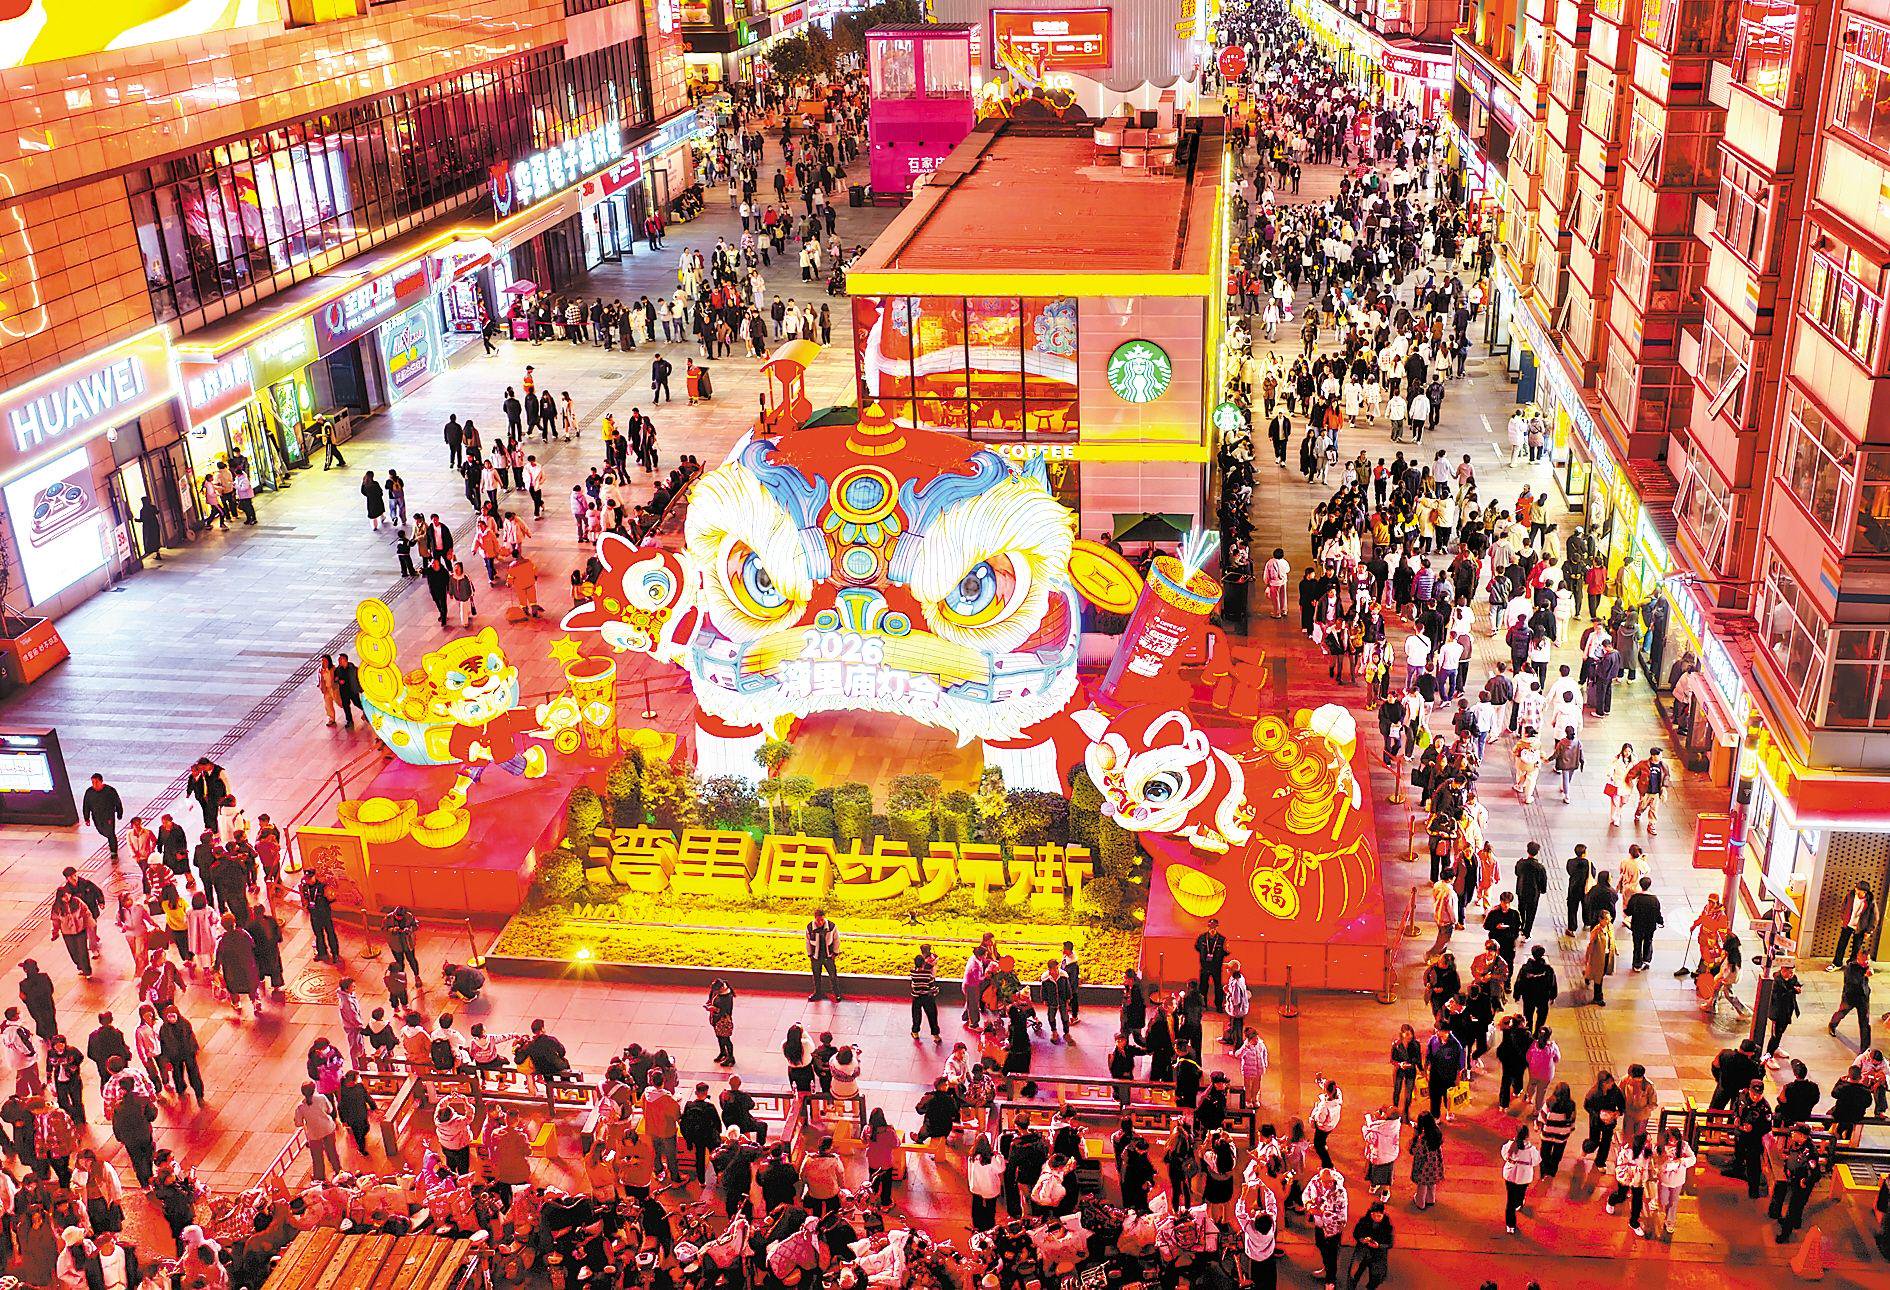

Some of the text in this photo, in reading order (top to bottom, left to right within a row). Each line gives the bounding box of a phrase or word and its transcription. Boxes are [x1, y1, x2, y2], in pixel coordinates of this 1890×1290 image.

[8, 355, 146, 452] HUAWEI
[999, 444, 1075, 460] COFFEE
[800, 629, 886, 666] 2026
[586, 824, 1094, 907] 湾里庙步行街
[1259, 878, 1288, 910] 福
